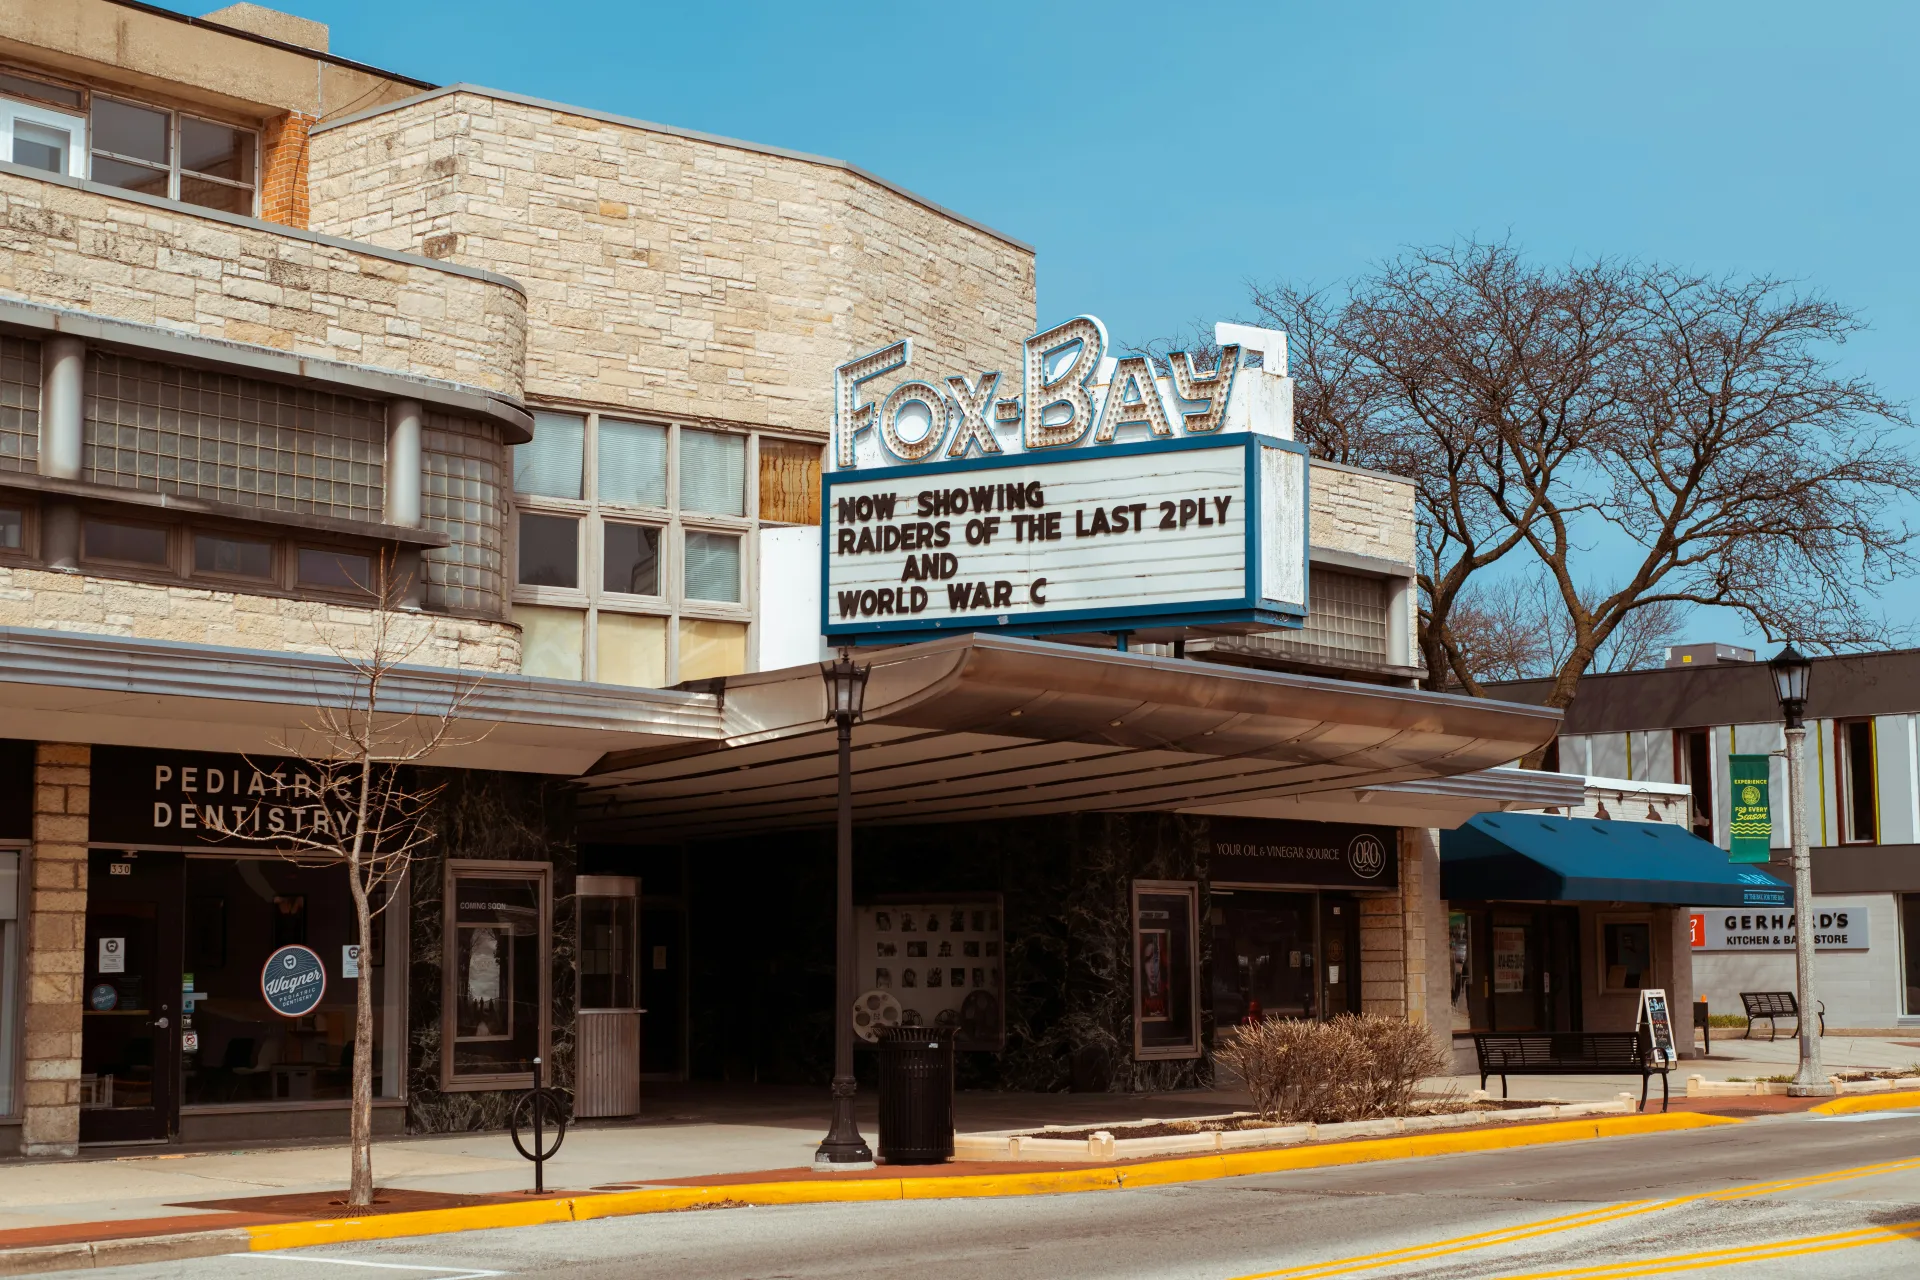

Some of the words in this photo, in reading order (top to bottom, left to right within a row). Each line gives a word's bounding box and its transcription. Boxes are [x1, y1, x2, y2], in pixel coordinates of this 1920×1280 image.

[838, 493, 896, 524] NOW
[917, 481, 1044, 517] SHOWING
[838, 520, 950, 555] RAIDERS
[965, 516, 1001, 546] OF
[1011, 511, 1062, 542] THE
[1076, 503, 1147, 537] LAST
[1159, 495, 1232, 530] 2PLY
[901, 552, 958, 582] AND
[838, 586, 928, 620] WORLD
[947, 580, 1013, 611] WAR
[1030, 578, 1047, 605] C
[155, 765, 352, 799] PEDIATRIC
[154, 802, 351, 835] DENTISTRY
[1736, 811, 1767, 821] Season
[1216, 843, 1242, 856] YOUR
[1243, 844, 1258, 857] OIL
[1260, 846, 1265, 856] &
[1266, 845, 1304, 859] VINEGAR
[1306, 847, 1340, 860] SOURCE
[111, 864, 130, 874] 330
[460, 902, 487, 910] COMING
[487, 902, 507, 910] SOON
[1725, 912, 1849, 931] GERHAD'S
[1726, 935, 1770, 945] KITCHEN
[1772, 935, 1781, 945] &
[1814, 934, 1848, 944] STORE
[266, 969, 321, 995] Wagner
[279, 987, 316, 1002] PEDIATRIC
[282, 994, 313, 1007] DENTISTRY
